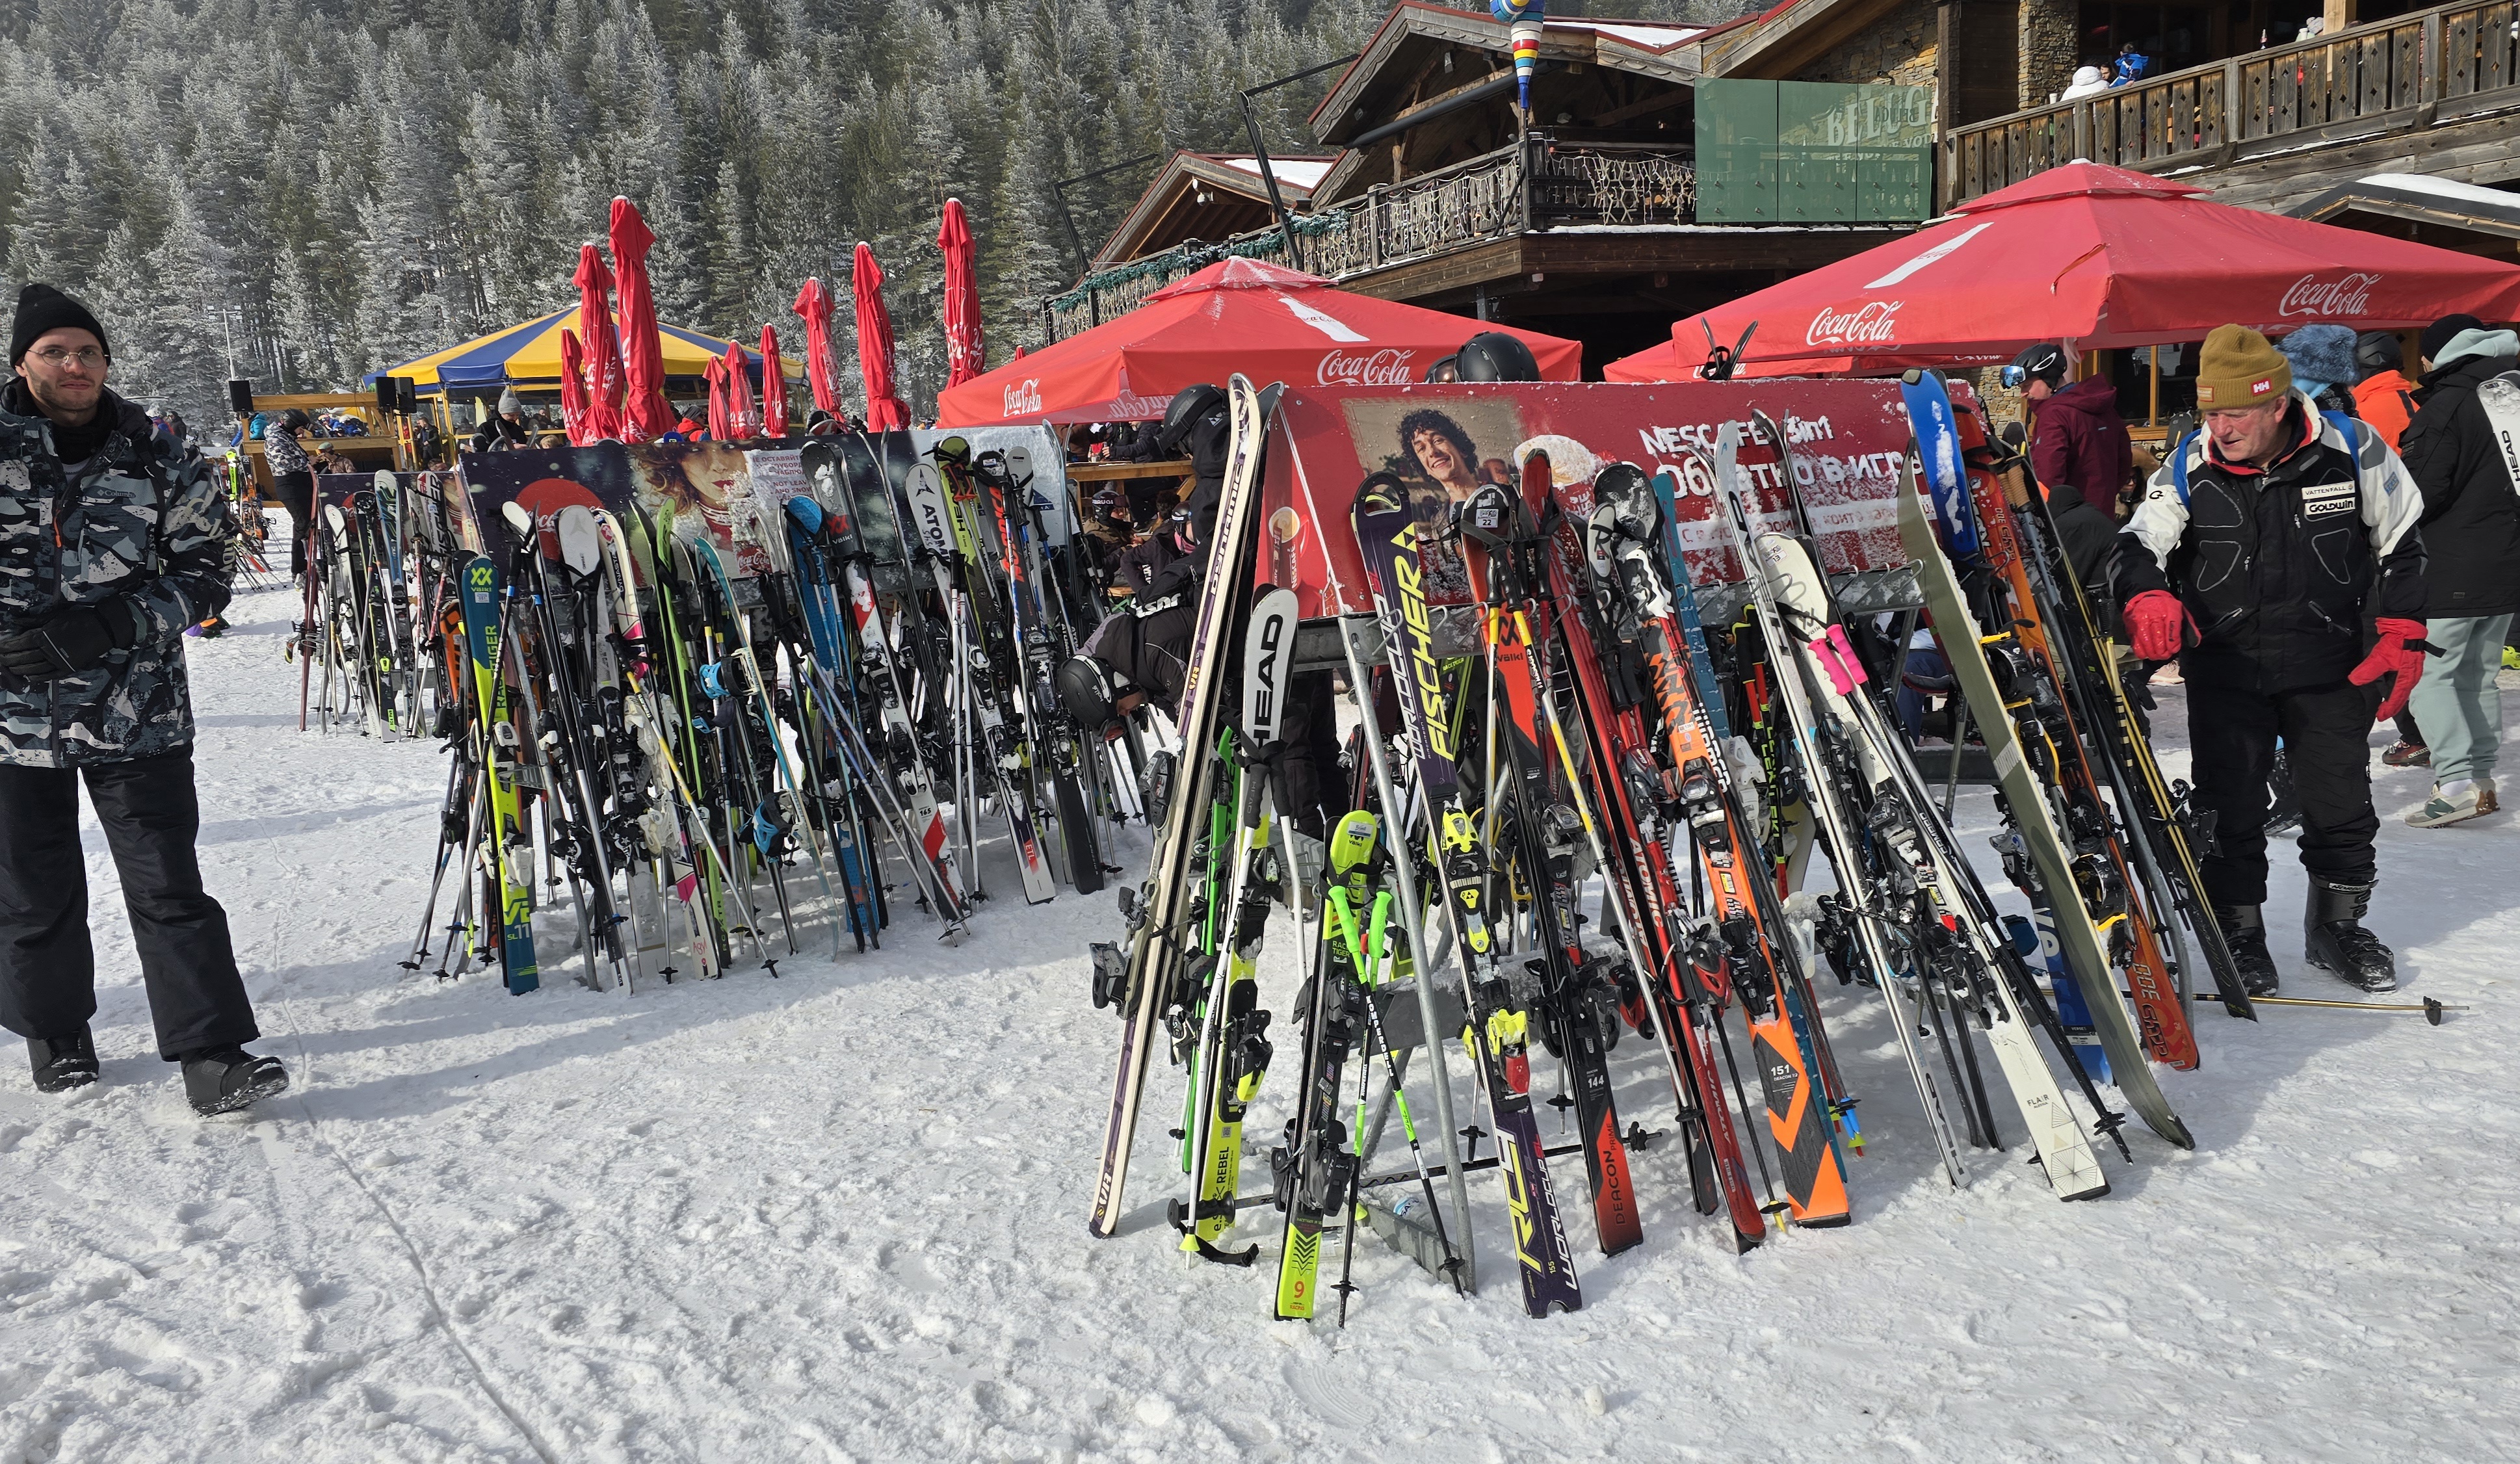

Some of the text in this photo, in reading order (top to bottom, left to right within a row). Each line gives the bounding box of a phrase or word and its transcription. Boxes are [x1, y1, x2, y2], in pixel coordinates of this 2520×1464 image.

[2279, 273, 2383, 317] Coca-Cola
[1806, 300, 1906, 346] Coca-Cola
[1317, 348, 1416, 385] Coca-Cola
[1003, 378, 1042, 417] Coca-Cola
[761, 454, 800, 464] ОСТАВЯЙТ
[2501, 430, 2520, 482] HEAD
[2305, 486, 2346, 496] VATTENFALL
[921, 503, 951, 563] ATOMI
[1394, 555, 1454, 762] FISCHER
[1252, 614, 1285, 748] HEAD
[919, 807, 932, 817] 165
[1629, 837, 1664, 928] ATOMIC
[1332, 947, 1351, 958] TIGER
[2132, 962, 2162, 1002] 300
[1588, 1074, 1605, 1089] 144
[1770, 1064, 1790, 1076] 151
[2027, 1094, 2049, 1106] FLAIR
[1925, 1072, 1965, 1176] HEAD
[1216, 1146, 1230, 1184] REBEL
[1603, 1122, 1625, 1225] DEACON PRIME
[1548, 1260, 1556, 1275] 155
[1293, 1280, 1305, 1299] 9
